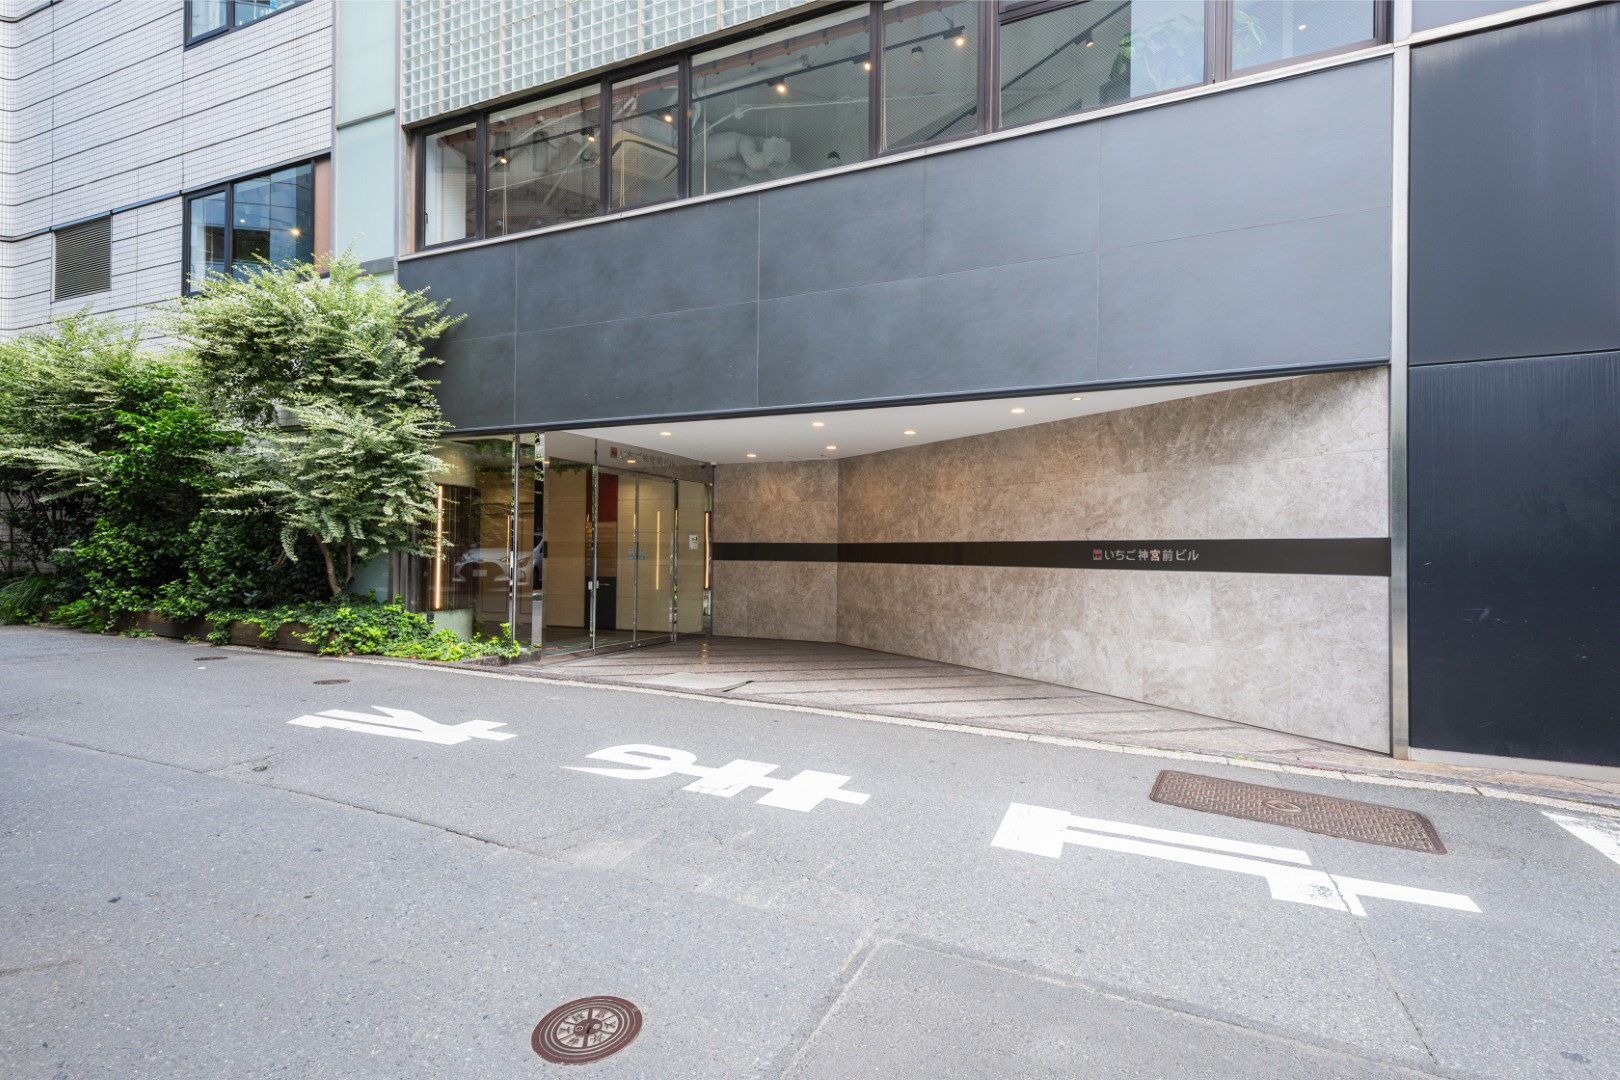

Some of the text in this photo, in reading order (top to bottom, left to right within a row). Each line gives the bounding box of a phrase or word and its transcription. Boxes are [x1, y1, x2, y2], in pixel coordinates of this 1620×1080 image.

[1104, 549, 1199, 561] いちご神宮前ビル
[287, 705, 1482, 917] 止まれ
